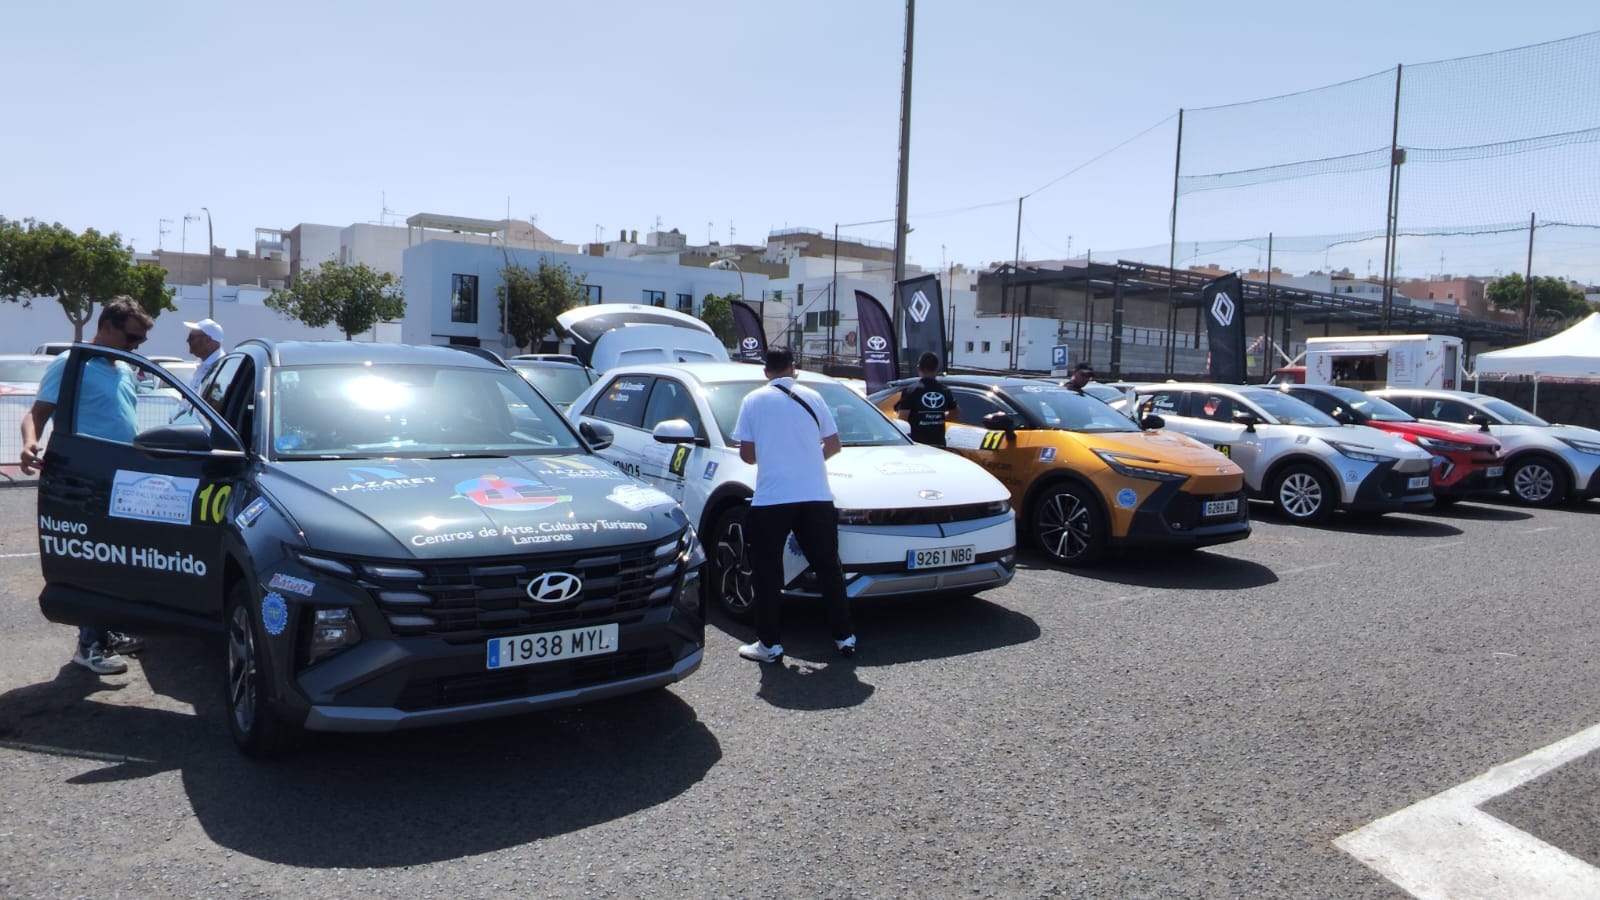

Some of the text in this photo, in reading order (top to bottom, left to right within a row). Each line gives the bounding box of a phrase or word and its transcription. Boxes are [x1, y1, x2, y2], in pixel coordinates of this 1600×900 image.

[1055, 350, 1064, 362] P
[983, 431, 1004, 449] 11
[674, 447, 686, 472] 8
[330, 477, 436, 493] NAZARET
[199, 483, 231, 523] 10
[40, 515, 88, 535] Nuevo
[411, 519, 648, 546] Centros de Arte, Cultura y Turismo
[512, 532, 574, 545] Lanzarote
[41, 535, 207, 576] TUCSON Híbrido
[917, 548, 972, 566] 9261 NBG
[507, 630, 609, 662] 1938 MYL
